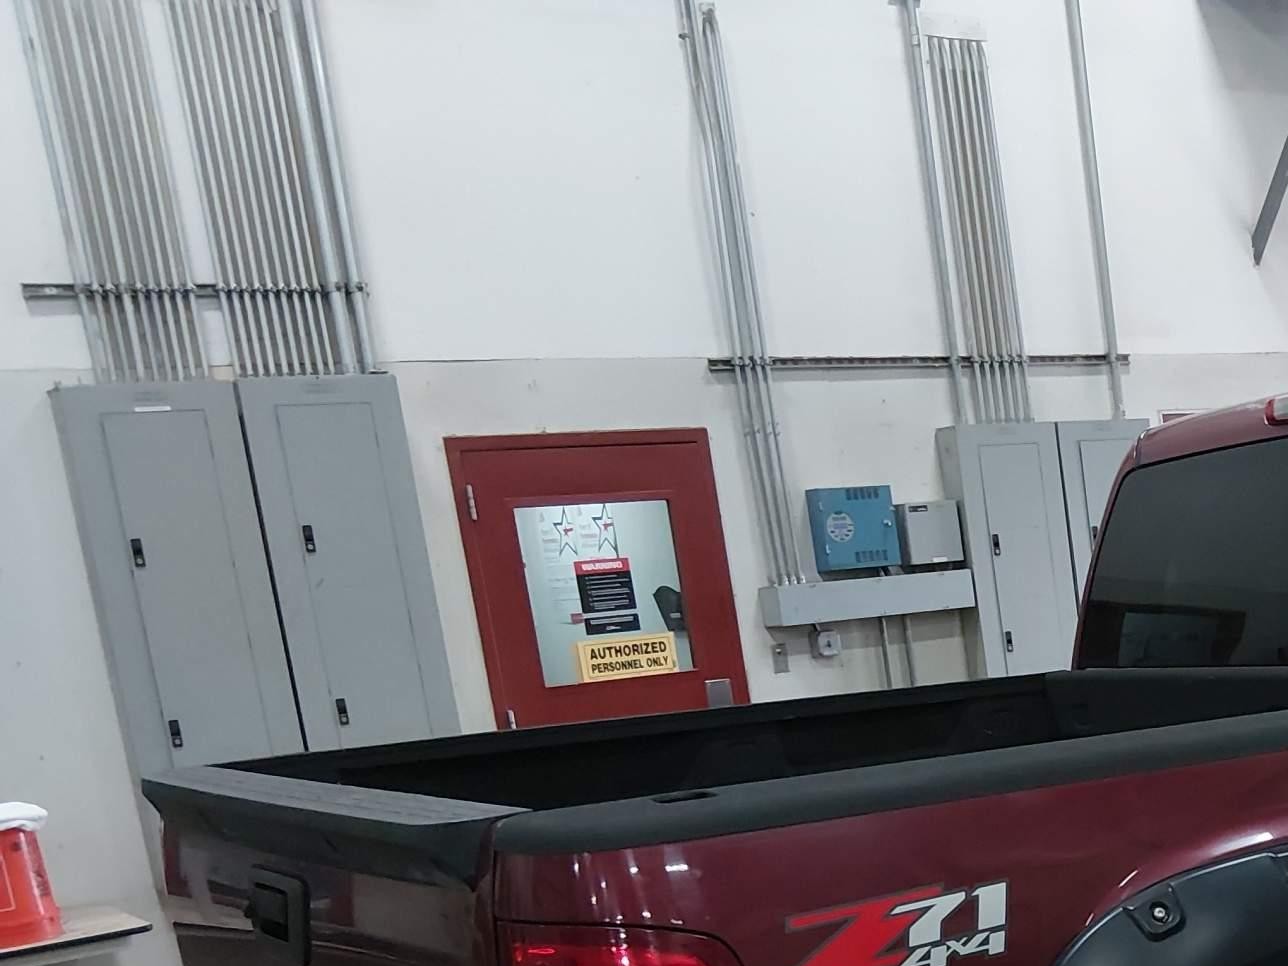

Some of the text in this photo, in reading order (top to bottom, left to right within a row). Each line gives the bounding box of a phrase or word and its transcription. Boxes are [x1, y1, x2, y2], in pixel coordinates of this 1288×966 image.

[590, 641, 667, 660] AUTHORIZED
[591, 656, 669, 674] PERSONNEL ONLY
